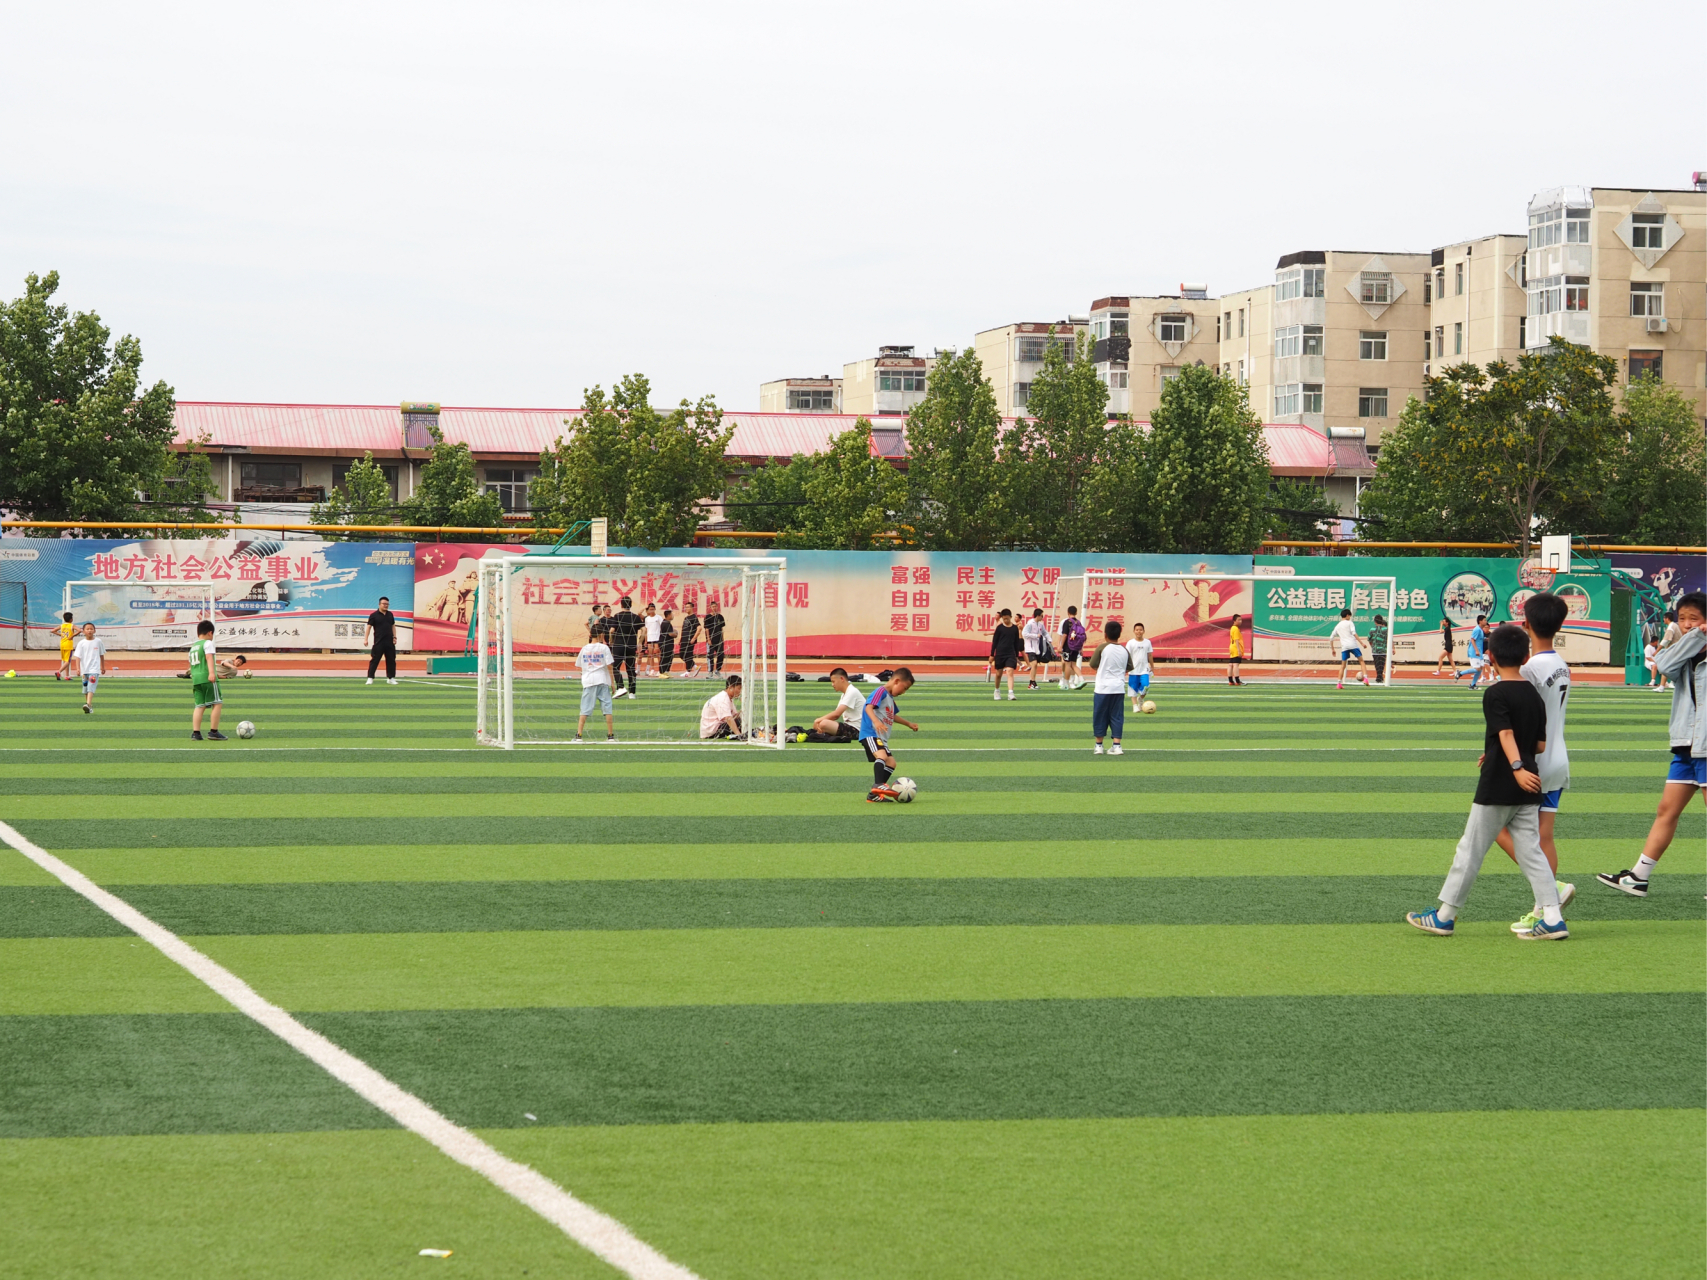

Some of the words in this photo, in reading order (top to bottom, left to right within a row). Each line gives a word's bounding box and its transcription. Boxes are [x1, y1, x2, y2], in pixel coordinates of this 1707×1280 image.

[93, 553, 320, 582] 地方社会公益事业
[890, 566, 931, 585] 富强
[957, 566, 996, 585] 民主
[1021, 566, 1061, 586] 文明
[1086, 567, 1126, 587] 和谐
[891, 589, 930, 608] 自由
[956, 590, 996, 609] 平等
[1021, 590, 1061, 609] 公正
[1086, 591, 1125, 610] 法治
[1266, 587, 1346, 610] 公益惠民
[1353, 588, 1429, 610] 各具特色
[218, 627, 257, 636] 公益体彩
[261, 627, 301, 636] 乐善人生
[890, 613, 930, 632] 爱国
[956, 613, 996, 632] 敬业
[1559, 684, 1568, 709] 7
